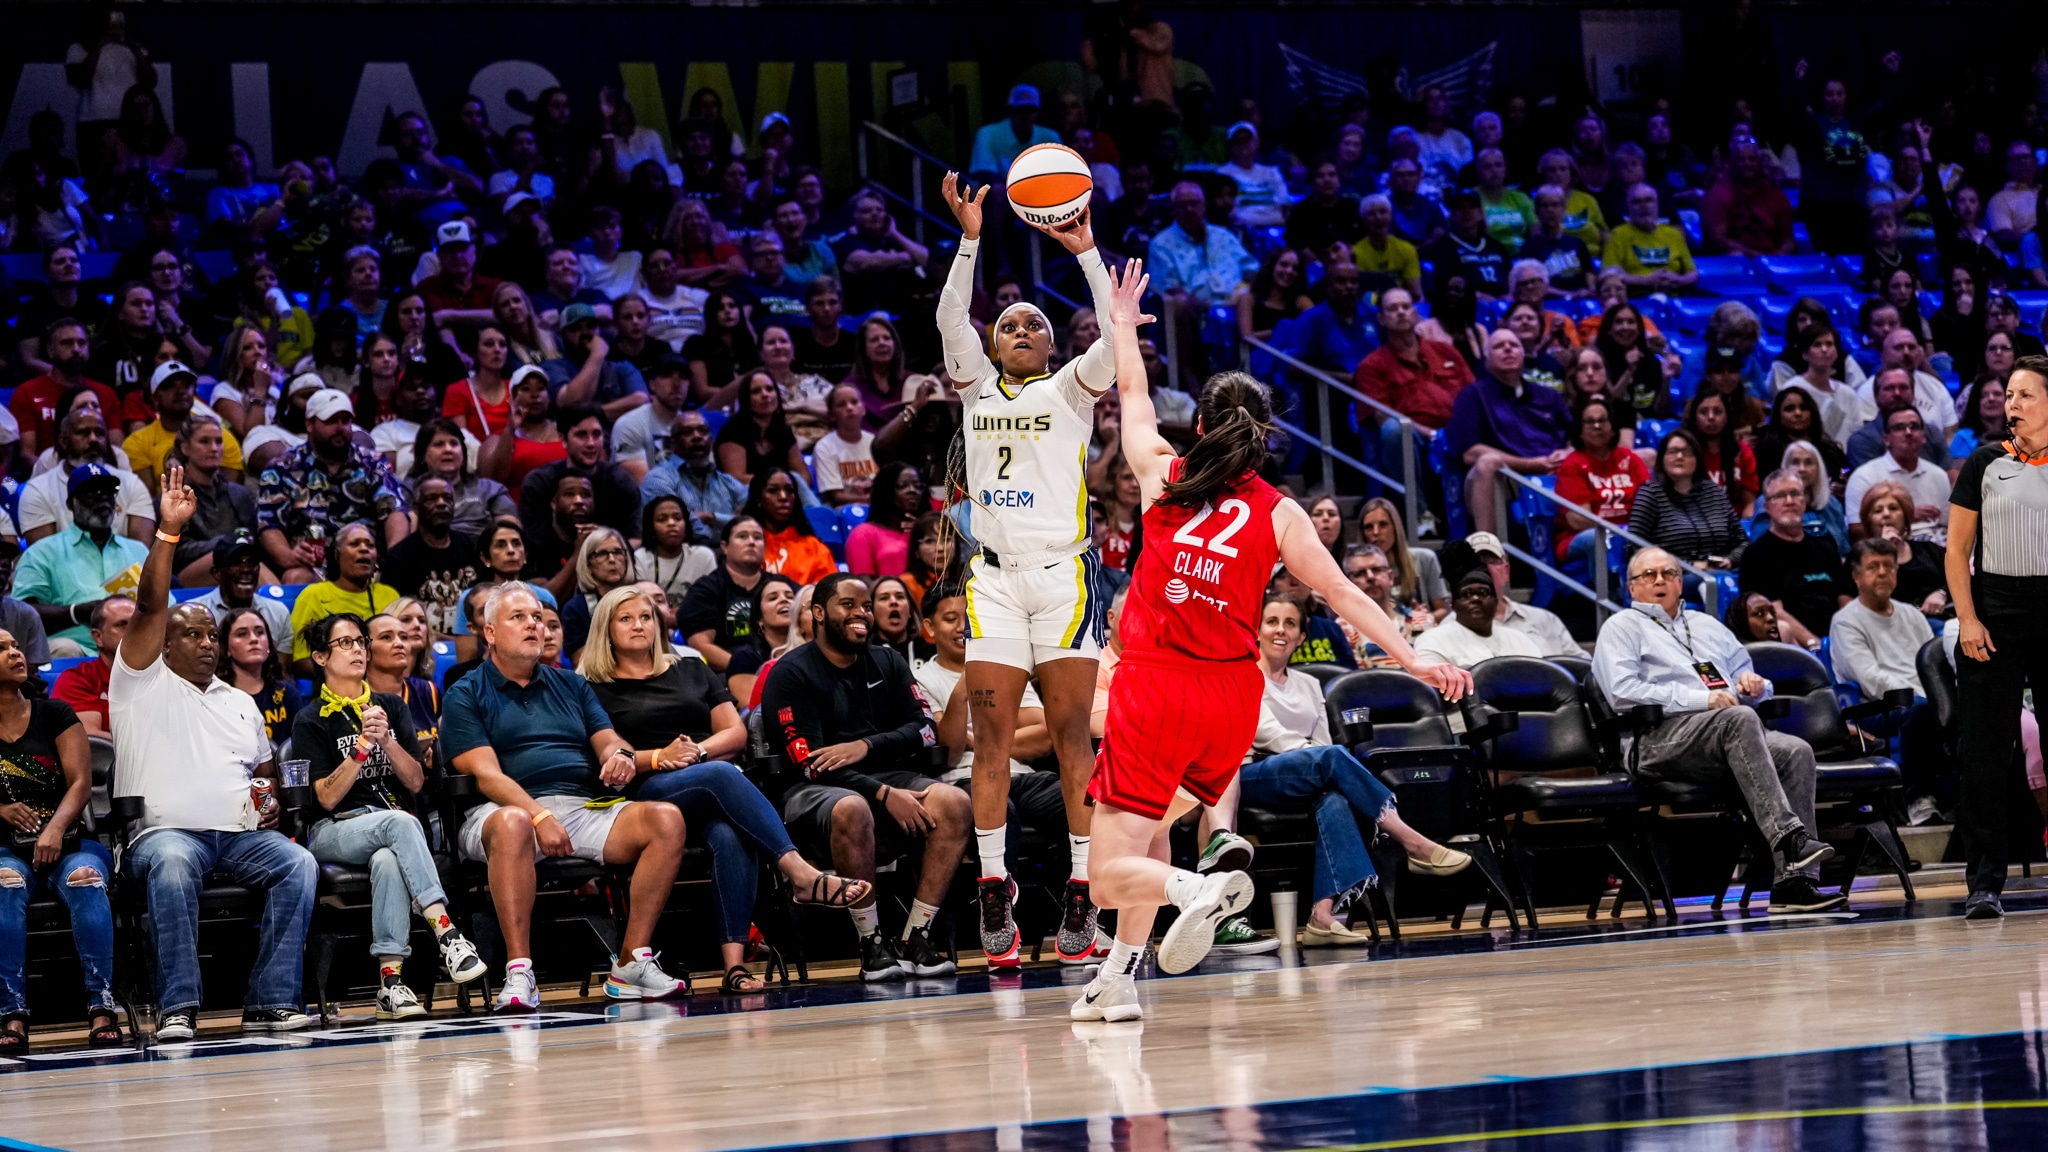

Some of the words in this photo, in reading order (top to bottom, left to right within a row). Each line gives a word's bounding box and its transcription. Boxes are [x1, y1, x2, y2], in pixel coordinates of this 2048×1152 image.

[1024, 207, 1080, 226] Wilson
[972, 413, 1052, 431] WINGS
[997, 446, 1012, 480] 2
[993, 489, 1034, 509] GEM
[1600, 489, 1626, 510] 22
[1172, 498, 1251, 559] 22
[1174, 550, 1225, 585] CLARK
